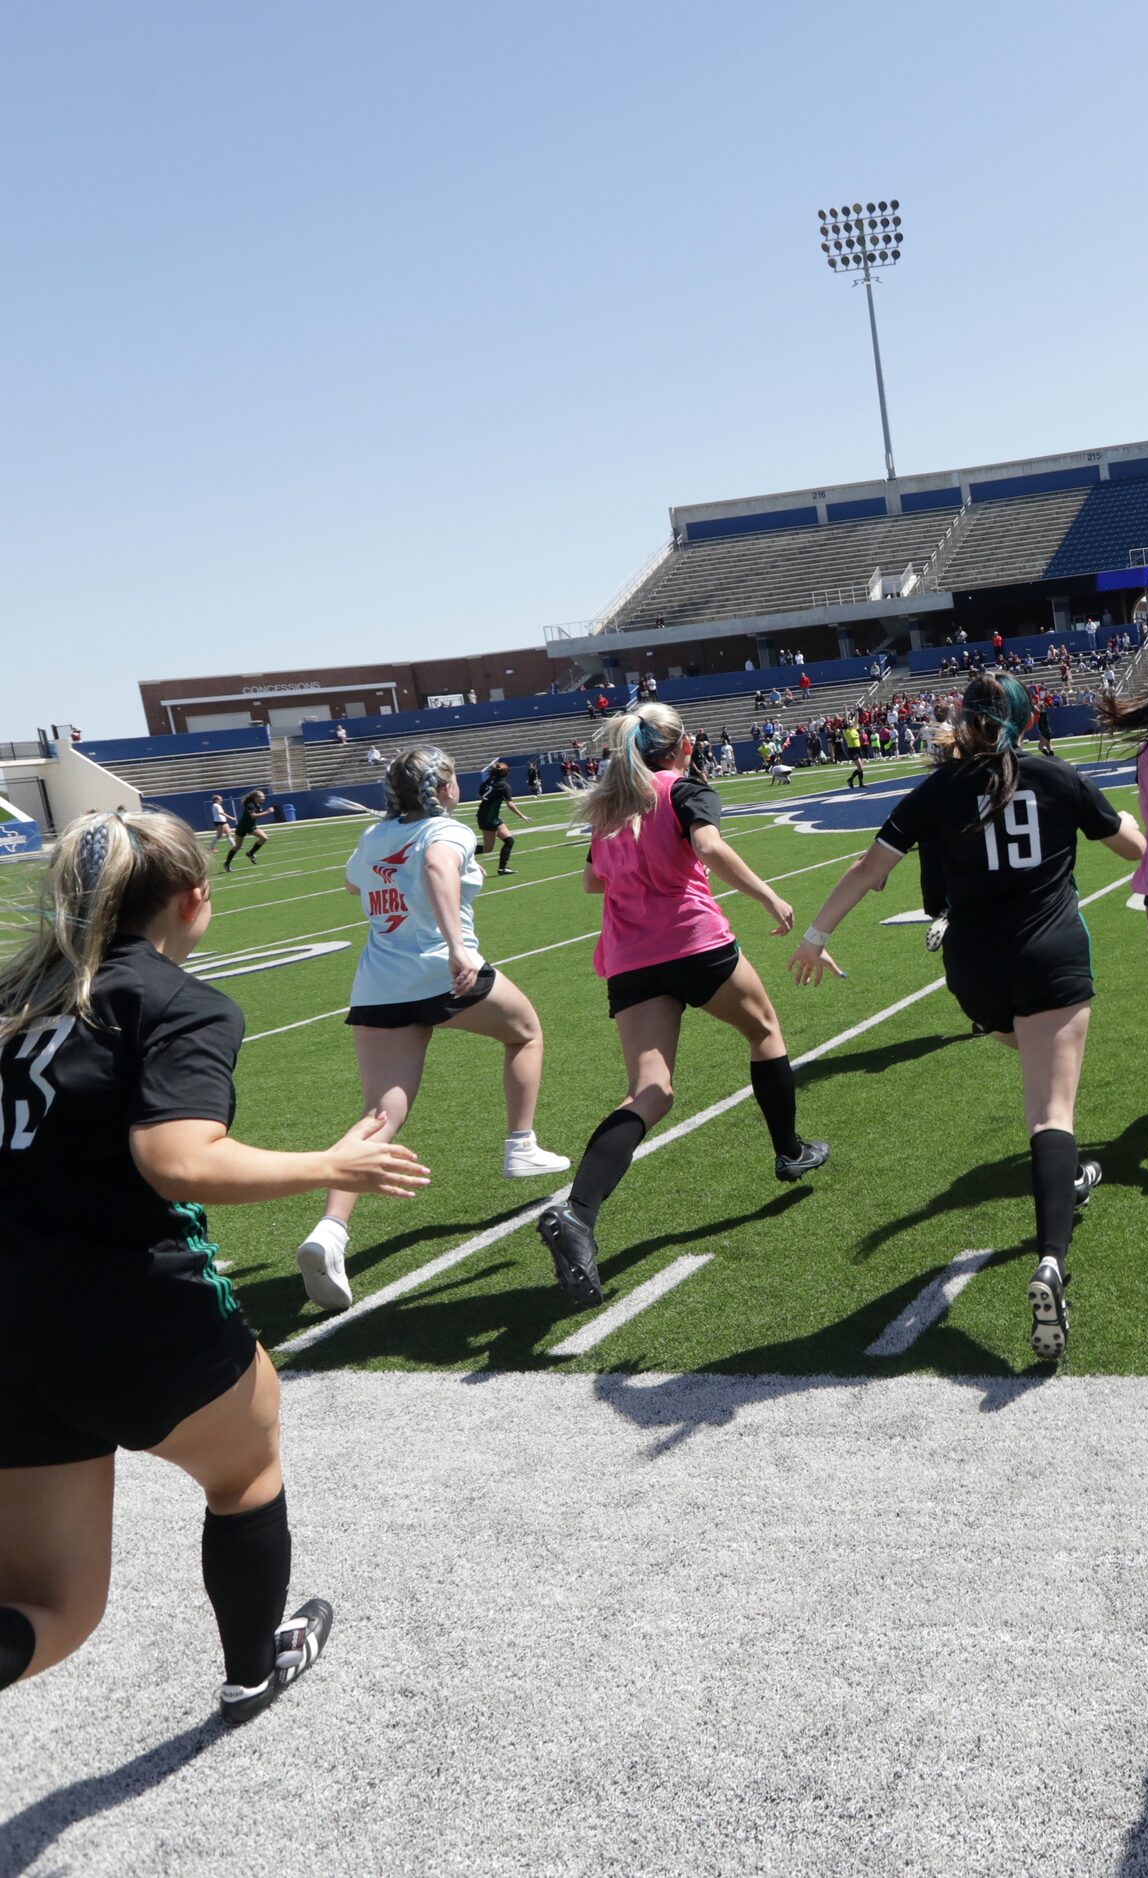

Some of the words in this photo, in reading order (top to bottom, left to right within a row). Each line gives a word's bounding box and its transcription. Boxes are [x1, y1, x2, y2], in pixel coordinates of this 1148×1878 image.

[241, 680, 321, 695] CONCESSIONS
[482, 784, 494, 801] 2
[976, 789, 1042, 871] 19
